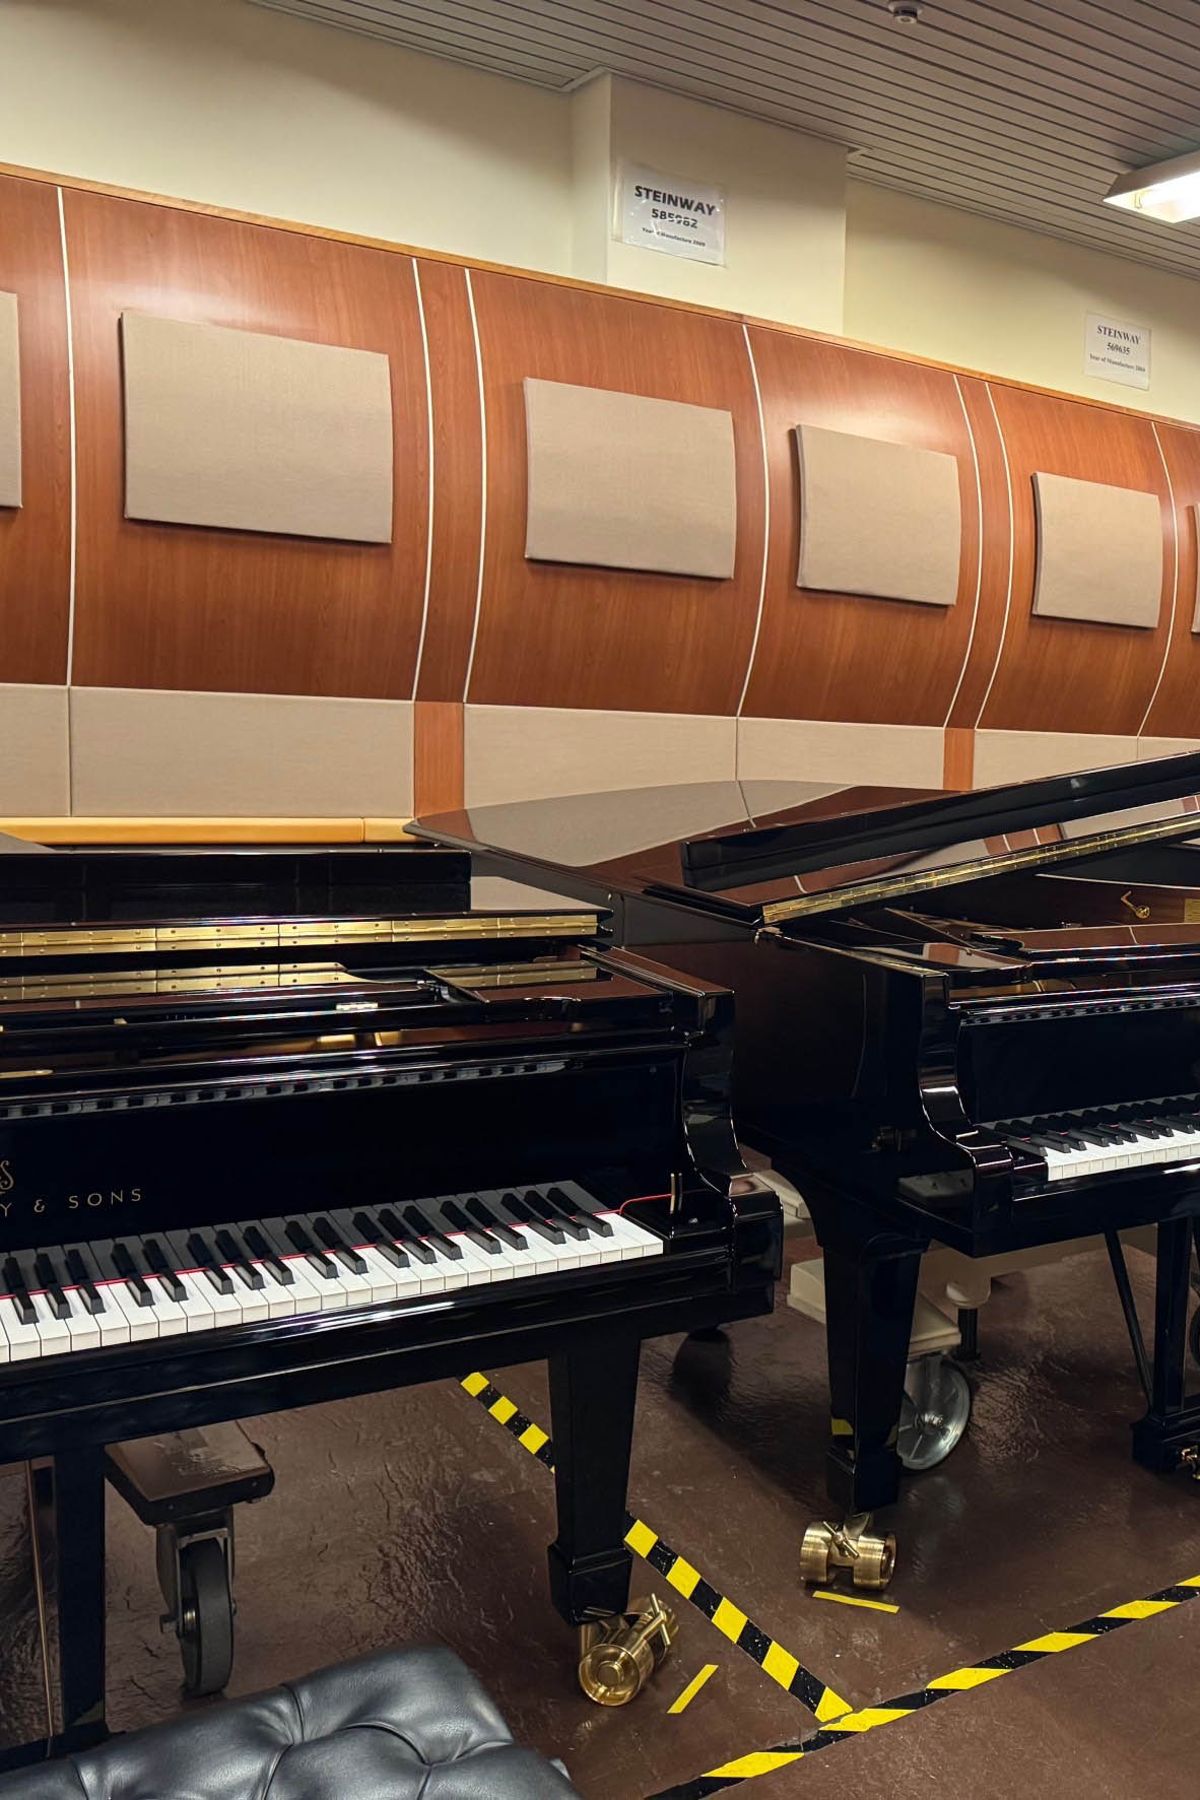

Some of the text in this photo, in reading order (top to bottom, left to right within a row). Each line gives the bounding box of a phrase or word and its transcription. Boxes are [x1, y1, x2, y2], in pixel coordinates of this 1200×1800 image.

[634, 185, 716, 216] STEINWAY
[1097, 325, 1141, 345] STEINWAY
[33, 1199, 46, 1213] &
[68, 1188, 142, 1209] SONS
